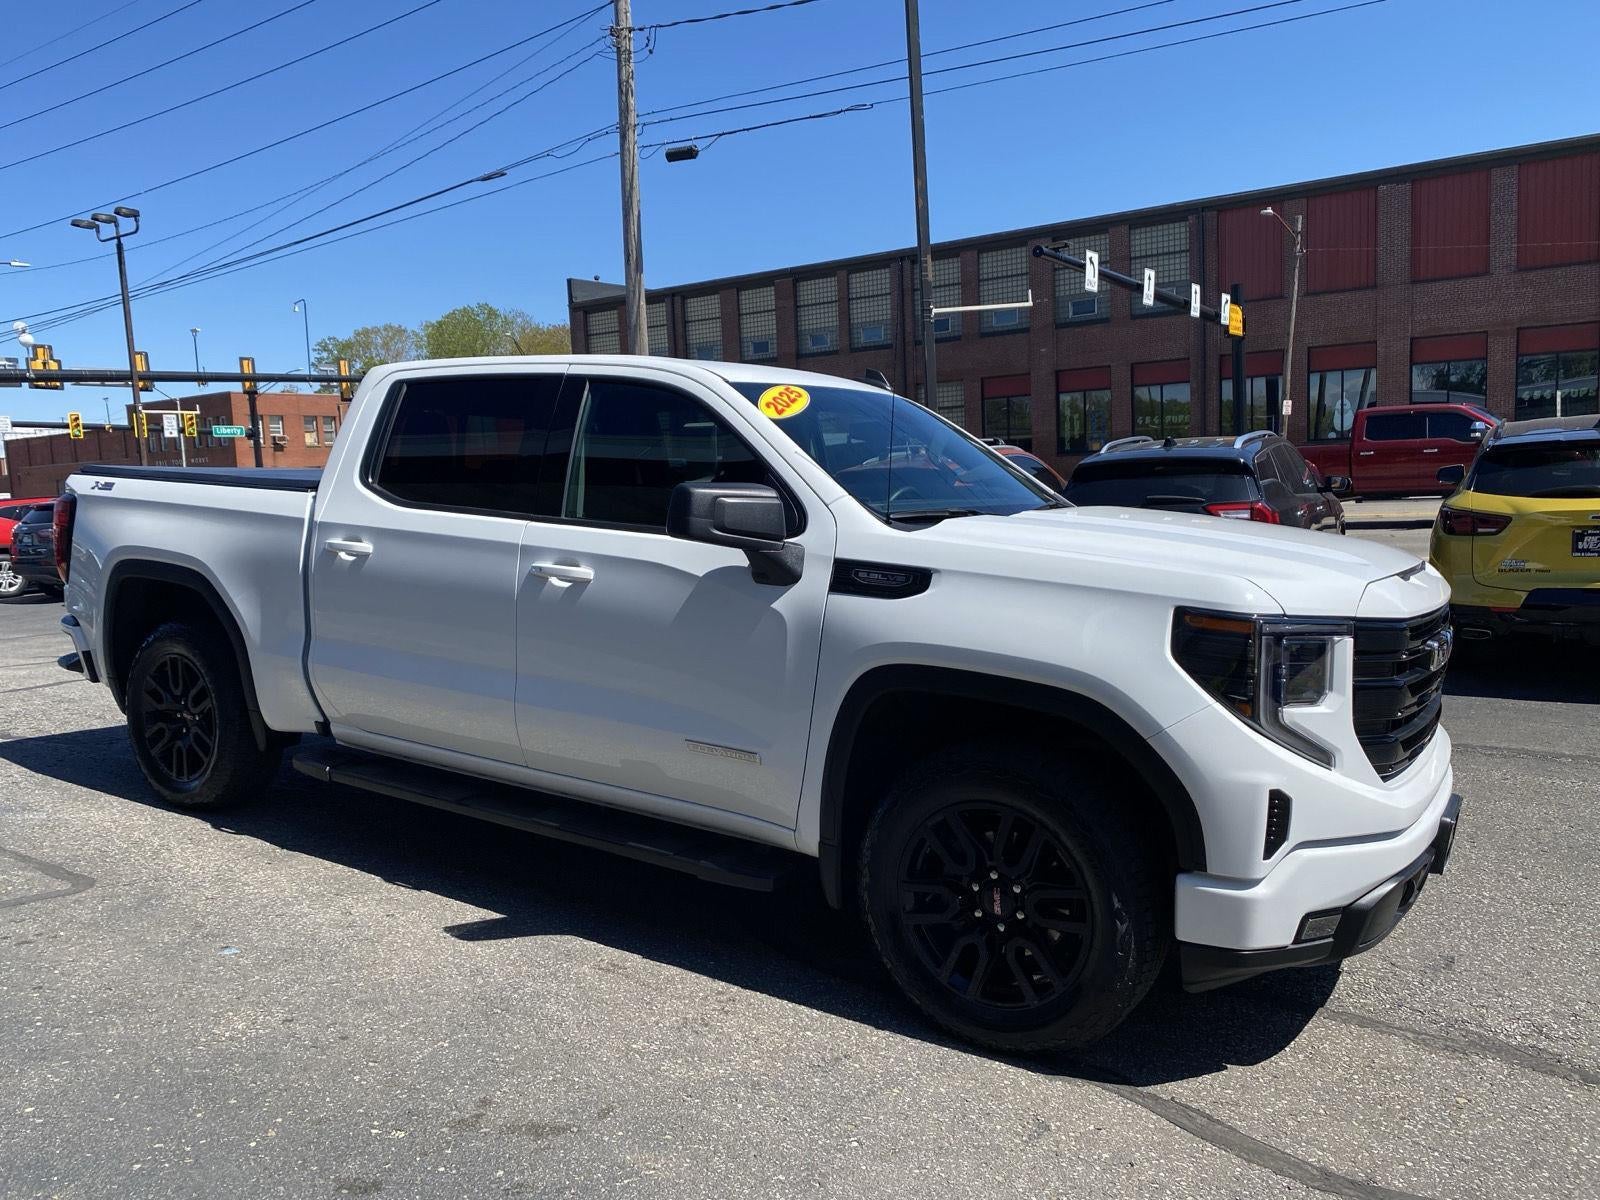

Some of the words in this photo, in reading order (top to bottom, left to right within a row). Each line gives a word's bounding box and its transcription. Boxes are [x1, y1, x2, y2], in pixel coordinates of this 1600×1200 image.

[765, 387, 803, 415] 2025
[216, 427, 241, 435] Liberty
[993, 887, 1001, 915] GMC
